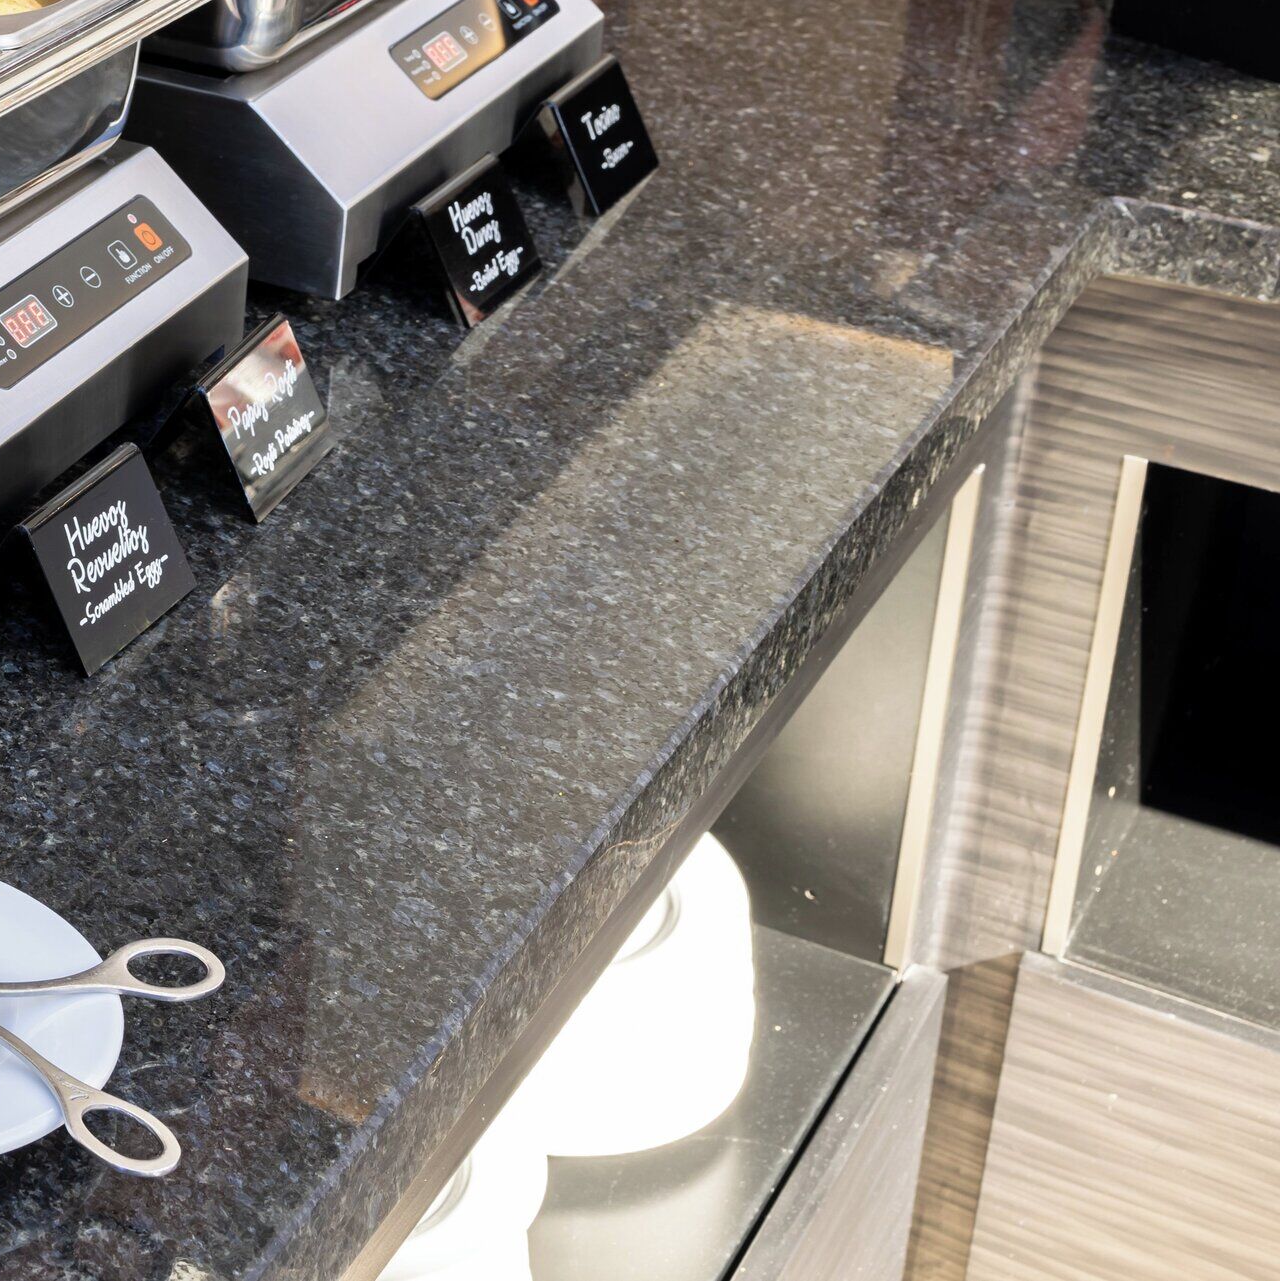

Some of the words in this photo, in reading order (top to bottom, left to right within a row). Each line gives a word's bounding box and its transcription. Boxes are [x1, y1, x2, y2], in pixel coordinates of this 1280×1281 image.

[124, 262, 152, 285] FUNCTION
[153, 245, 175, 264] ON/OFF
[63, 500, 128, 557] Huevos
[66, 524, 151, 594] Revueltos
